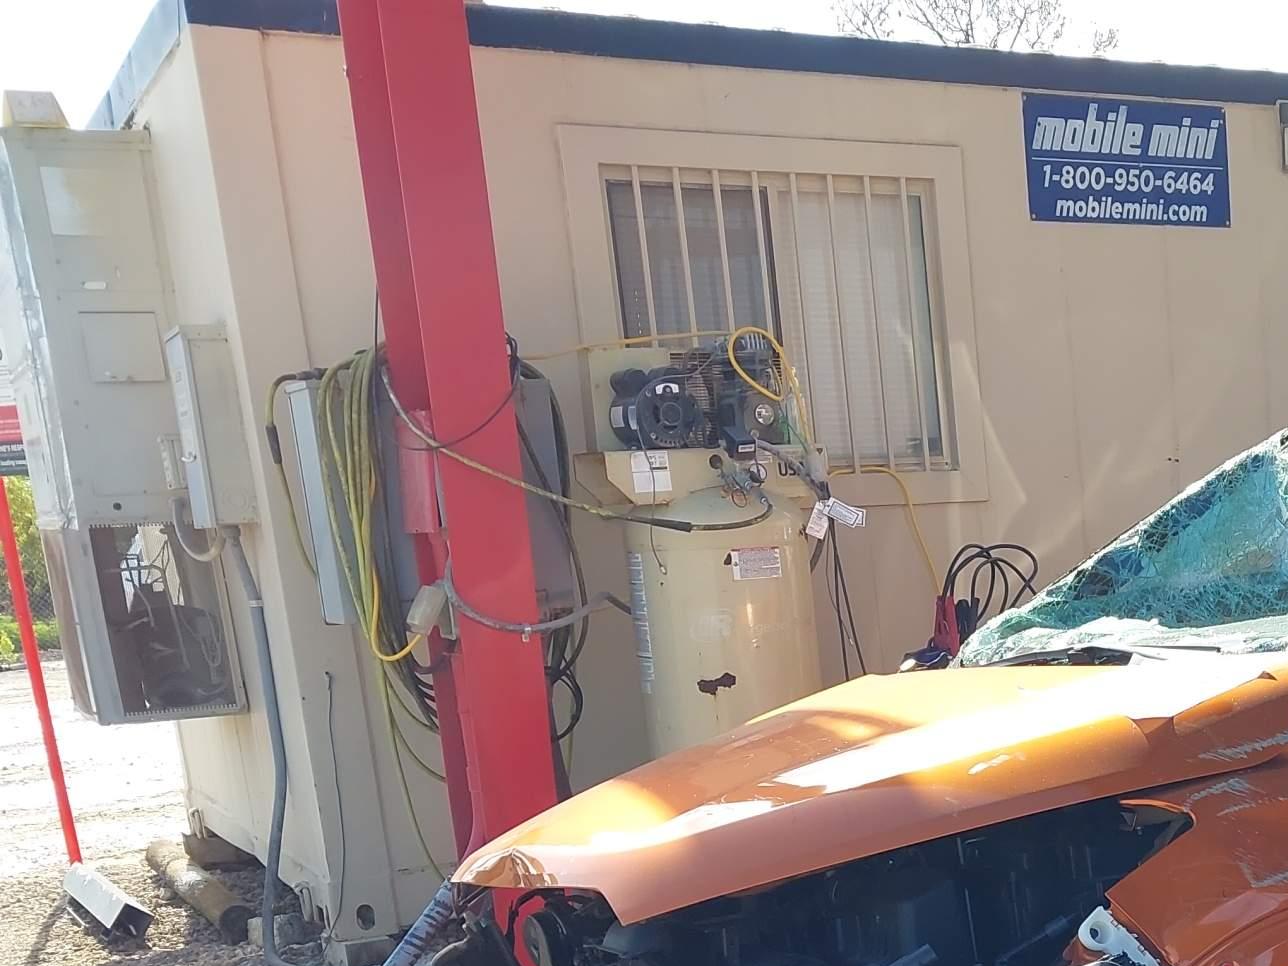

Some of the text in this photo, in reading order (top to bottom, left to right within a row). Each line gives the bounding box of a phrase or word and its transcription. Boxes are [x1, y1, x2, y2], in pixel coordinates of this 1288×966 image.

[1031, 102, 1220, 159] mobile mini
[1042, 164, 1215, 195] 1-800-950-6464
[1055, 195, 1208, 222] mobilemini.com
